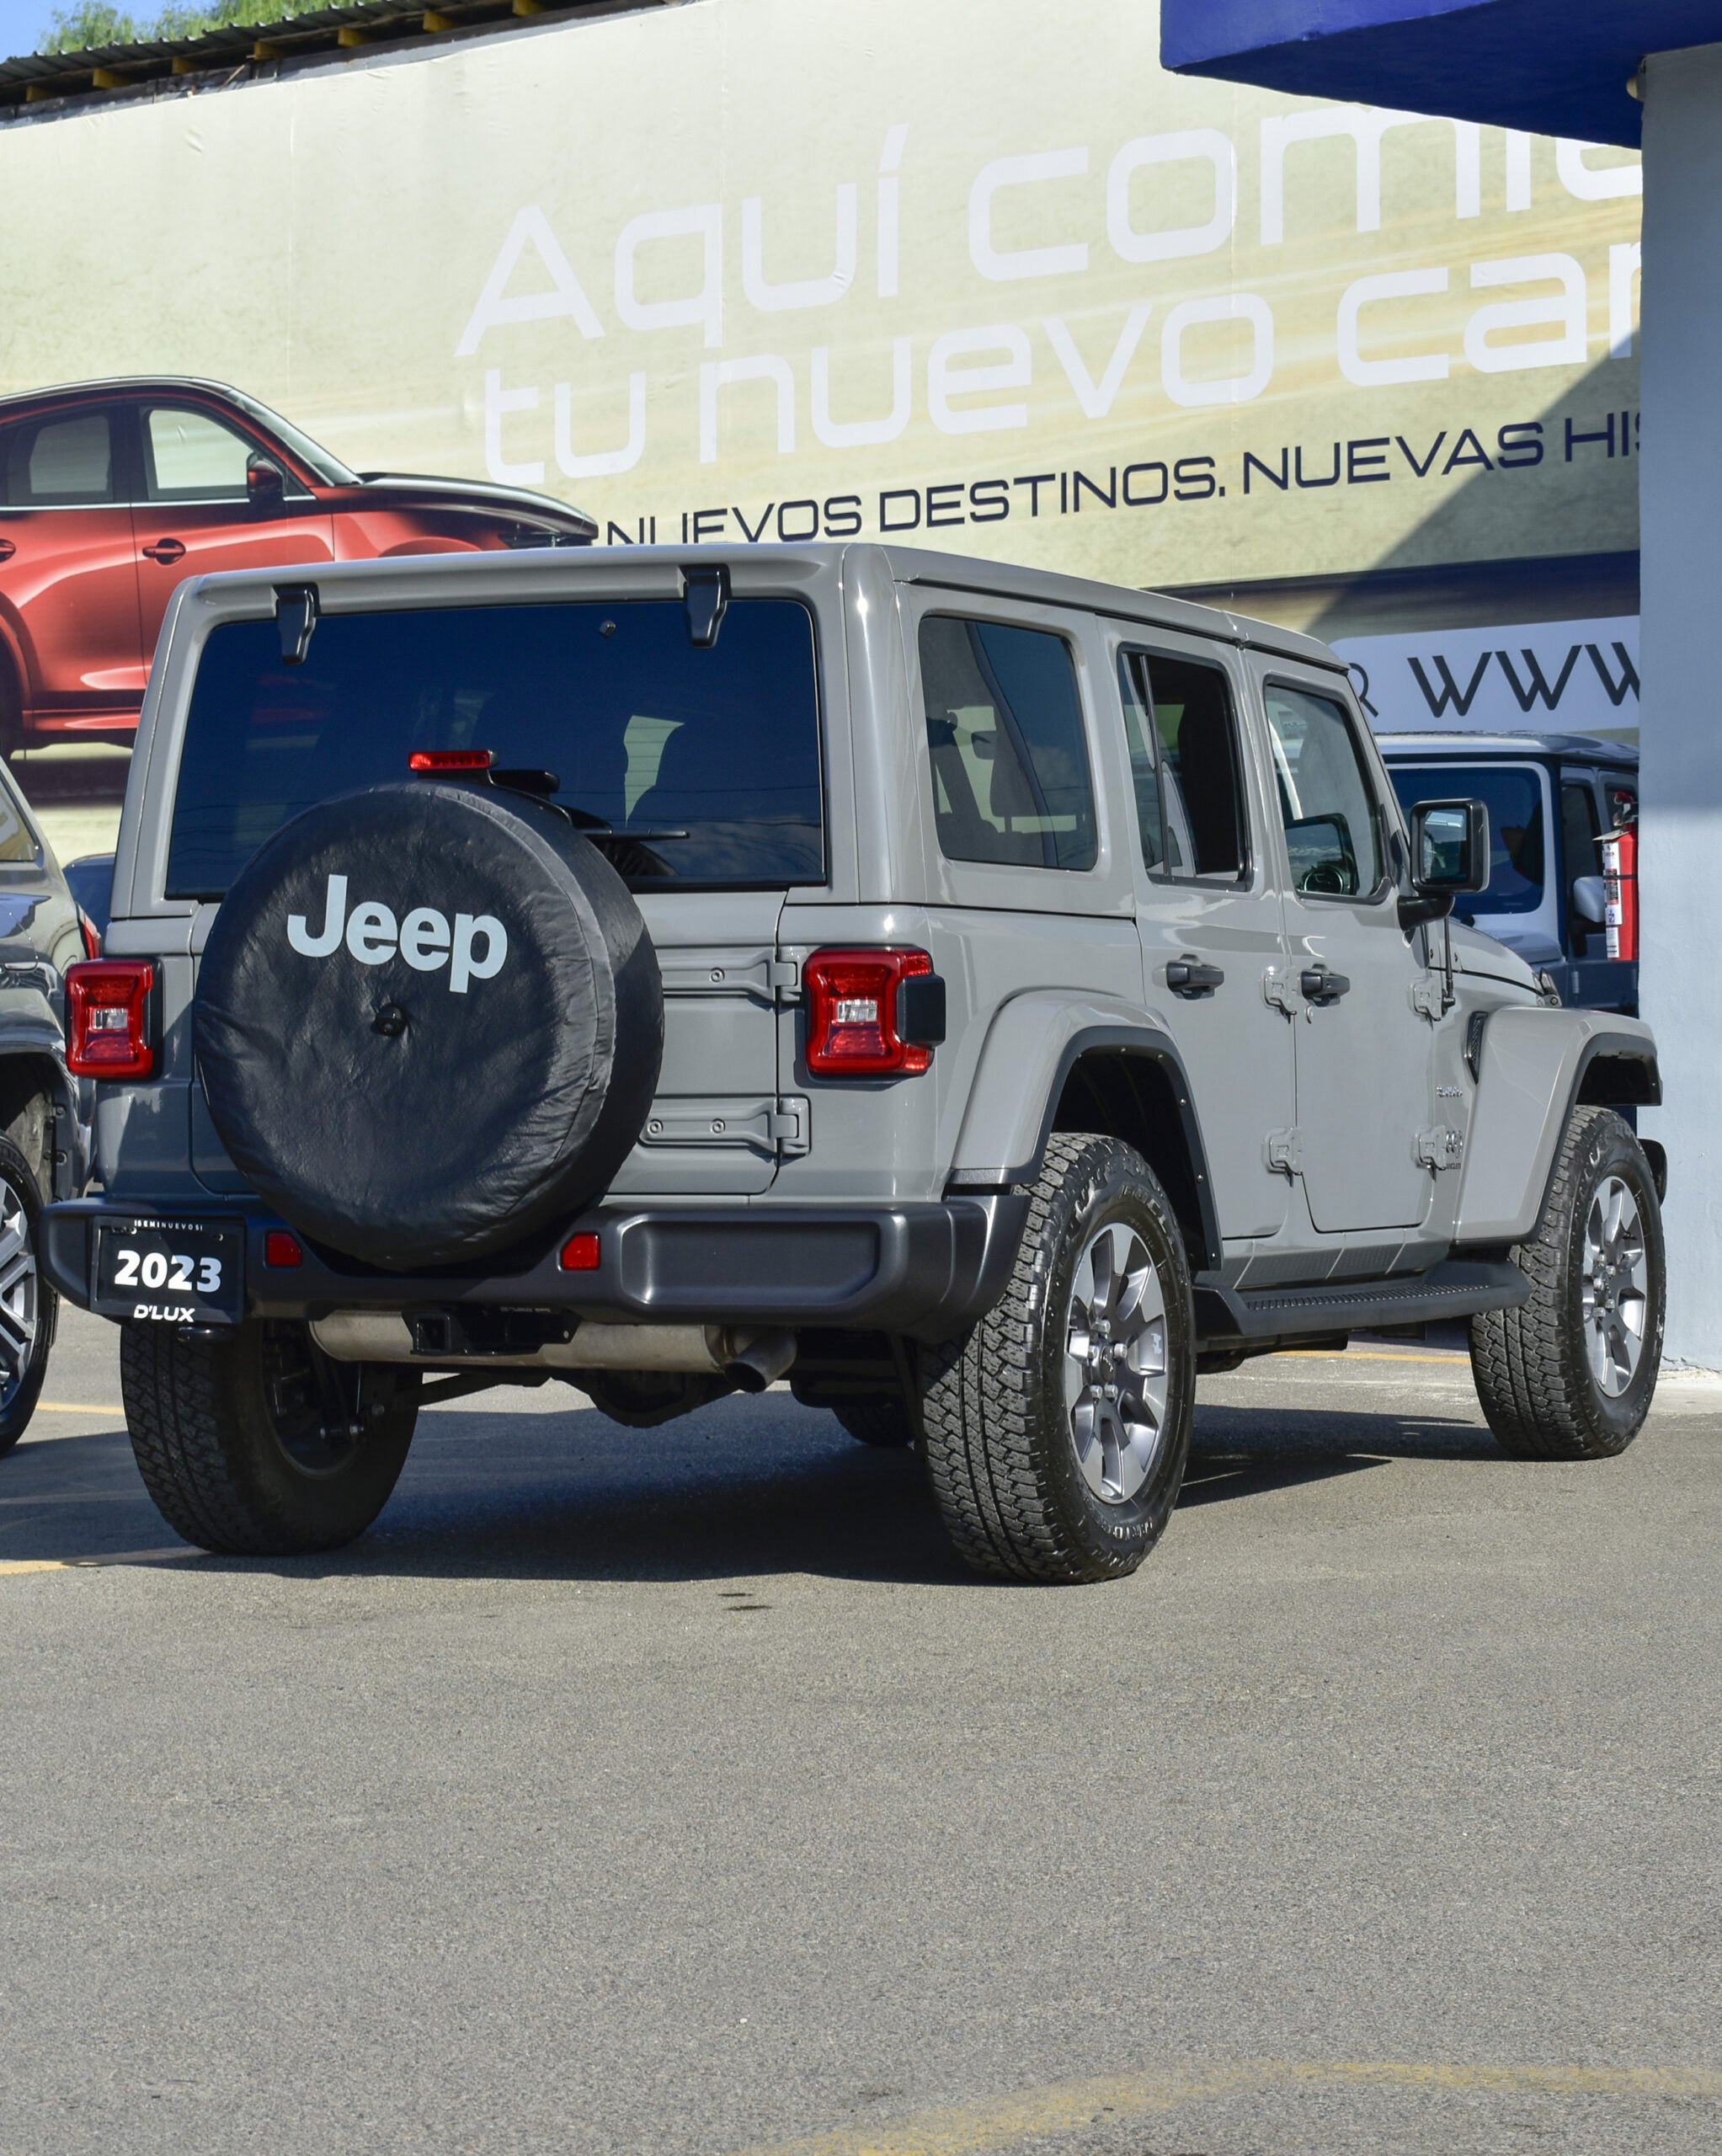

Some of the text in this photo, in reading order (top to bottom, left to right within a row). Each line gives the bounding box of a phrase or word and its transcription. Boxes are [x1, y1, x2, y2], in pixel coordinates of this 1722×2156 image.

[454, 123, 909, 357] Aquí
[484, 367, 647, 487] tu
[699, 292, 1274, 464] nuevo
[607, 411, 1639, 546] NUEVOS DESTINOS. NUEVAS HI
[287, 874, 508, 994] Jeep
[115, 1250, 222, 1293] 2023
[134, 1304, 195, 1323] D'LUX
